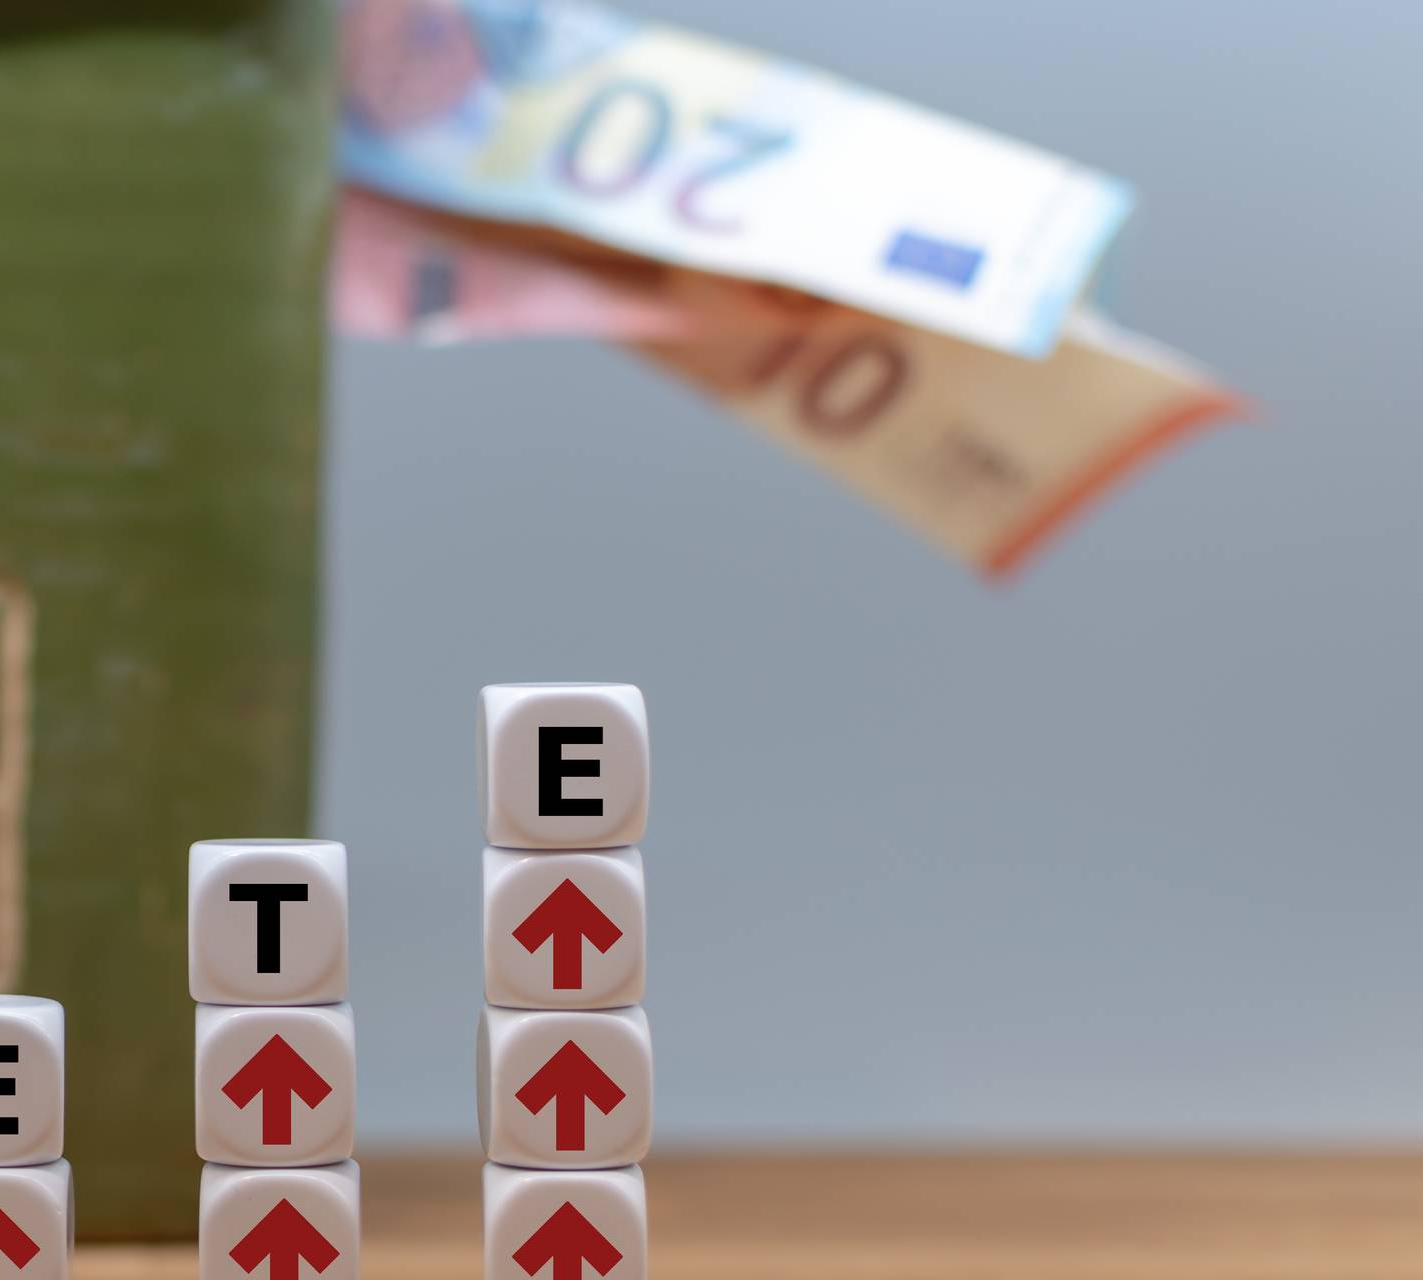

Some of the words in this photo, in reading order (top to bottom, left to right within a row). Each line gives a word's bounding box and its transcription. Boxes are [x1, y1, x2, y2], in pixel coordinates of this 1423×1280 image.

[553, 78, 799, 236] 20
[539, 727, 603, 816] E
[229, 884, 308, 973] T
